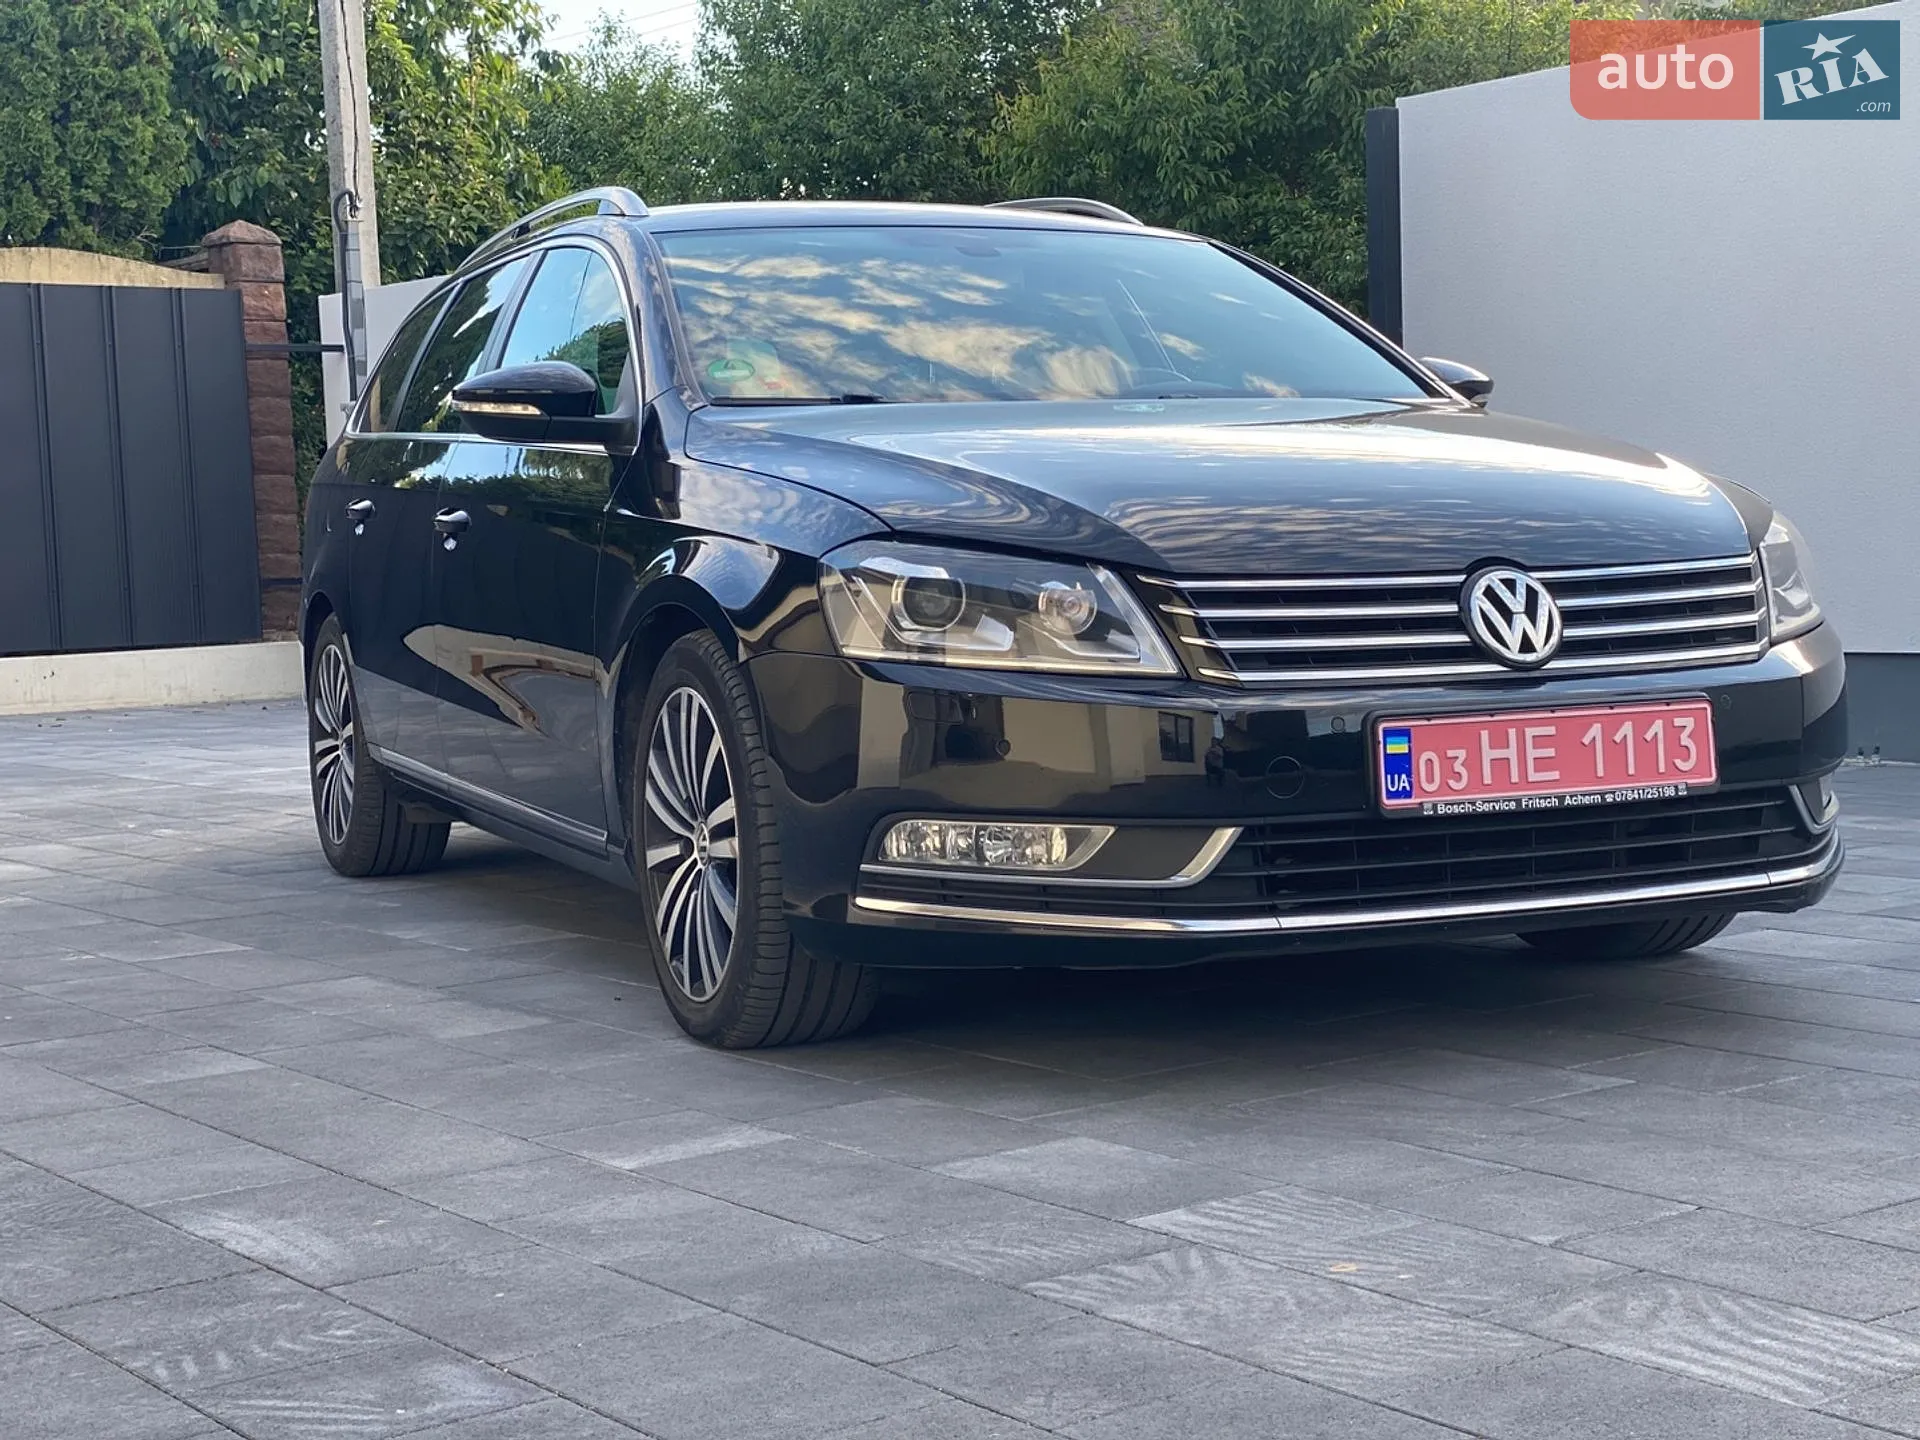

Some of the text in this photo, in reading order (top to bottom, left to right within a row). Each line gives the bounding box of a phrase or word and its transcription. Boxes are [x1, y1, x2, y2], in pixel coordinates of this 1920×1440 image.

[1418, 716, 1697, 793] 03 HE 1113
[1386, 773, 1411, 792] UA
[1437, 800, 1516, 814] Bosch-Service
[1522, 796, 1559, 808] Fritsch
[1564, 793, 1601, 805] Achern
